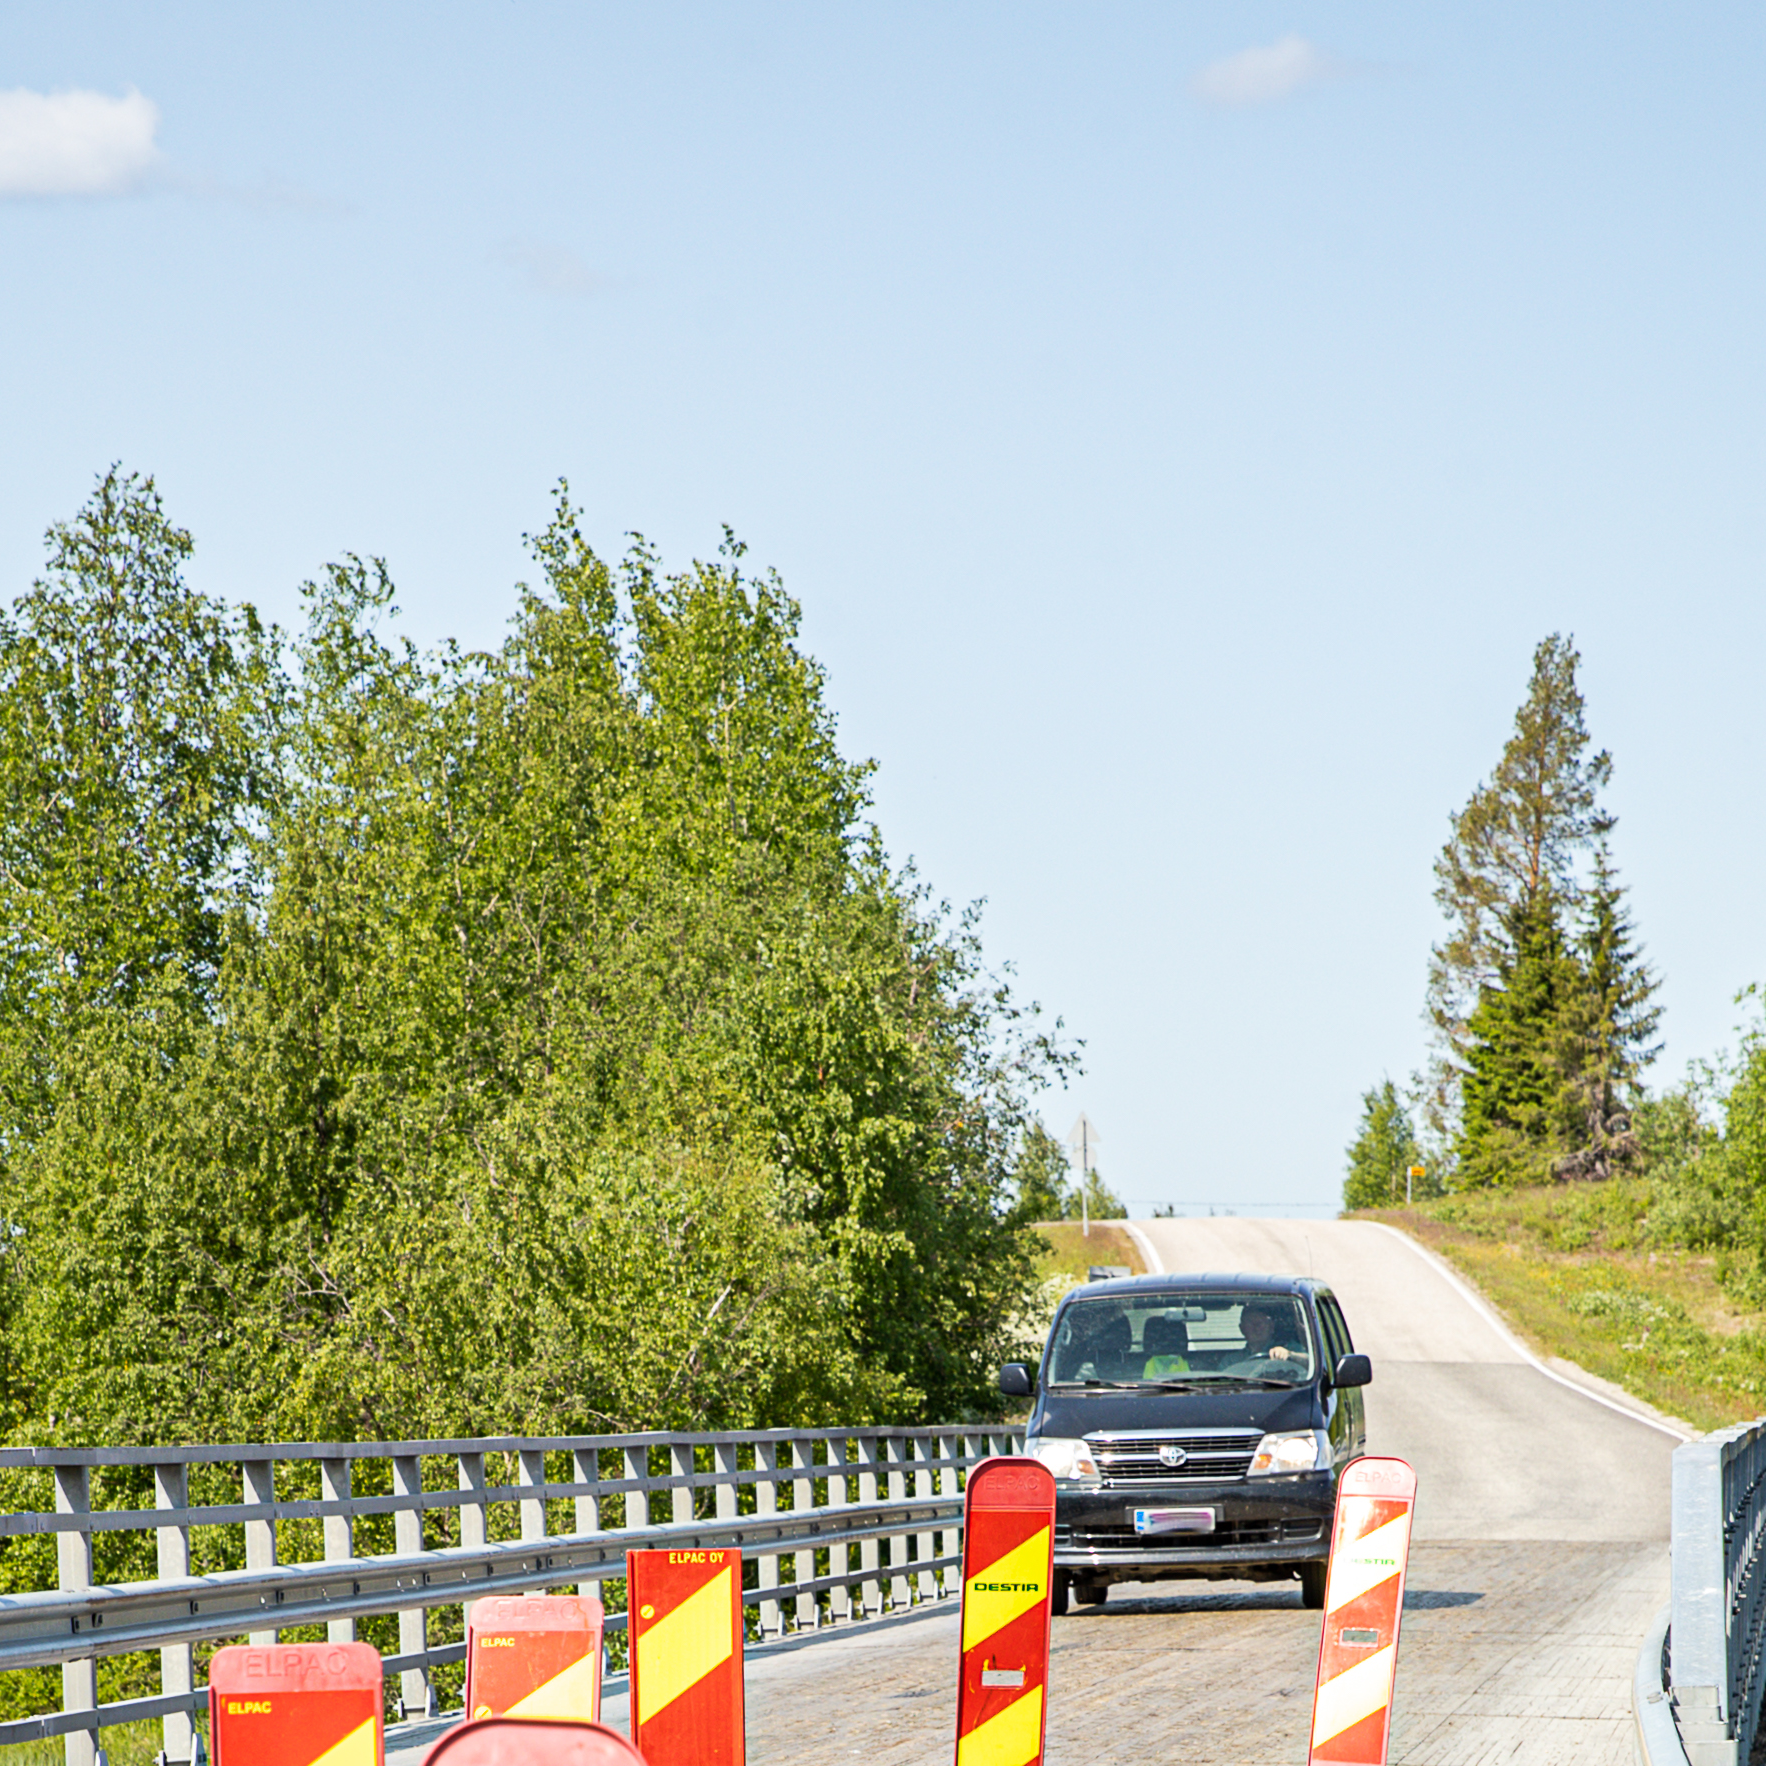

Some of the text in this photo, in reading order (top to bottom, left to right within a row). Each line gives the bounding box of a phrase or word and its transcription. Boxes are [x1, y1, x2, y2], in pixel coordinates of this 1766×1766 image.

[984, 1474, 1040, 1491] ELPAC
[1355, 1471, 1402, 1484] ELPAC
[669, 1552, 725, 1564] ELPAC OY
[974, 1582, 1039, 1592] DESTIA
[496, 1600, 579, 1619] ELPAC
[481, 1637, 515, 1648] ELPAC
[245, 1652, 349, 1678] ELPAC
[228, 1702, 272, 1714] ELPAC
